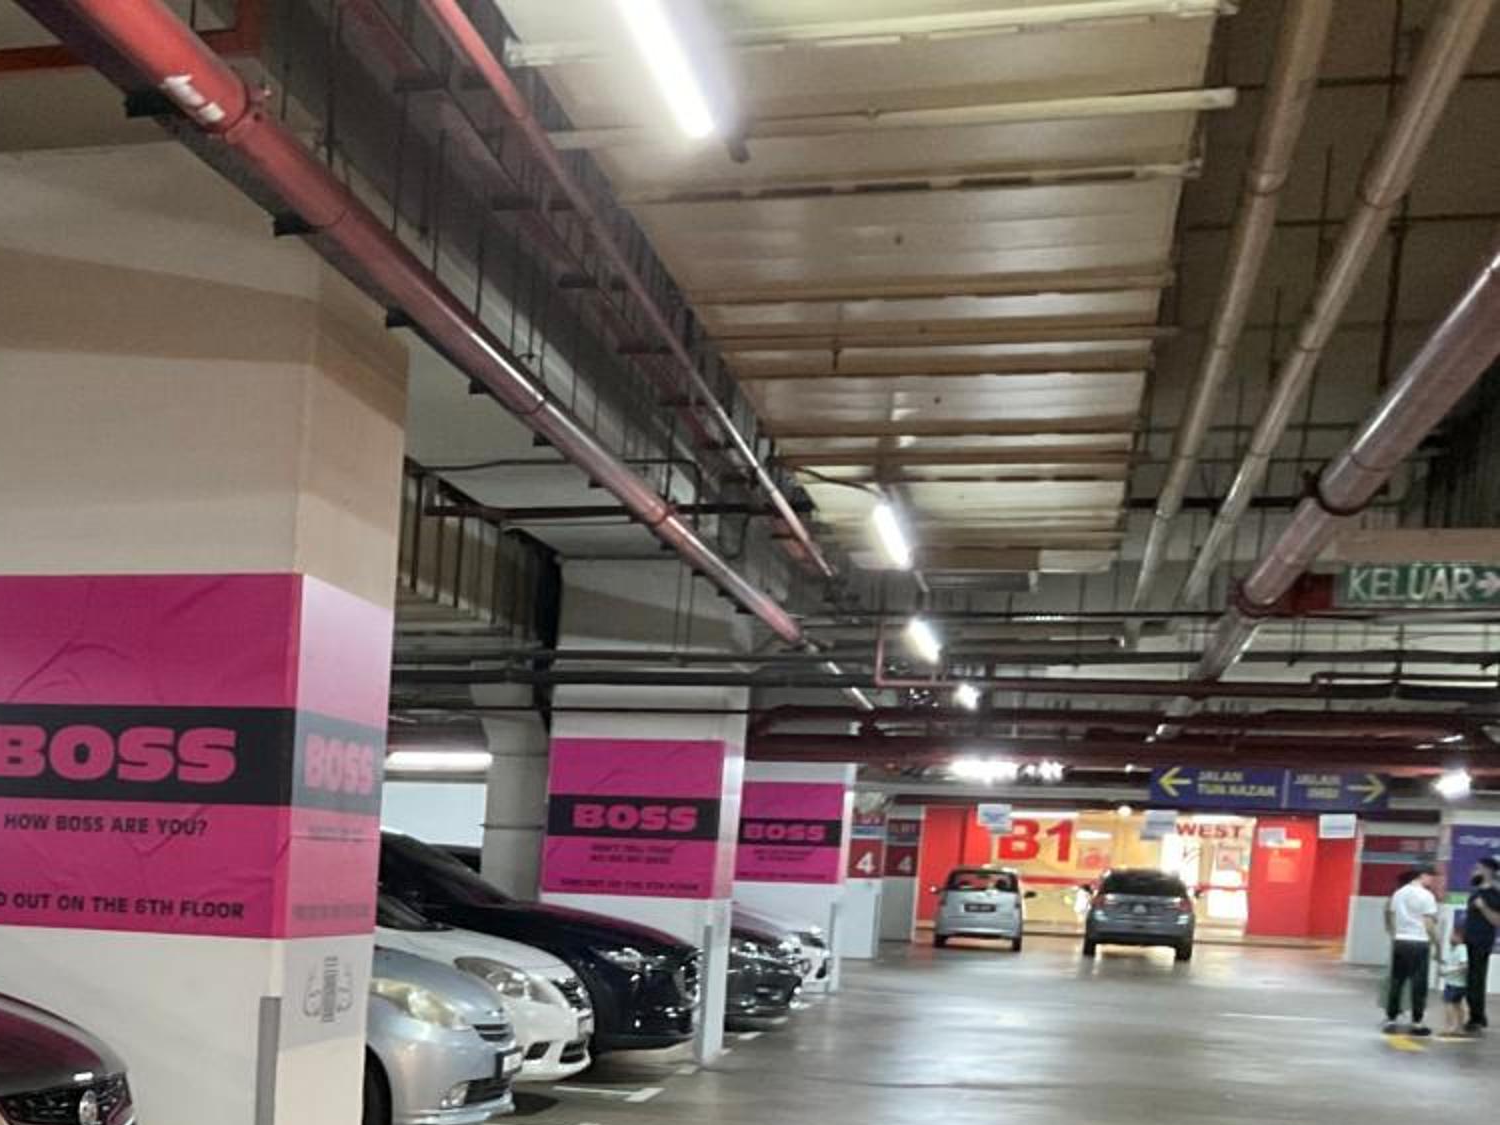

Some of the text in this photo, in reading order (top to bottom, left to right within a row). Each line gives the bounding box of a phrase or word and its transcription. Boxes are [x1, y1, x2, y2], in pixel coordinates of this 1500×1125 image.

[1349, 567, 1475, 600] KELUAR
[304, 733, 375, 796] BOSS
[4, 813, 207, 835] HOW BOSS ARE YOU?
[574, 803, 698, 833] BOSS
[743, 822, 826, 843] BOSS
[997, 819, 1073, 862] B1
[1176, 822, 1242, 840] WEST
[856, 851, 875, 874] 4
[13, 893, 51, 908] OUT
[57, 895, 85, 911] ON
[91, 896, 127, 912] THE
[180, 901, 244, 918] FLOOR
